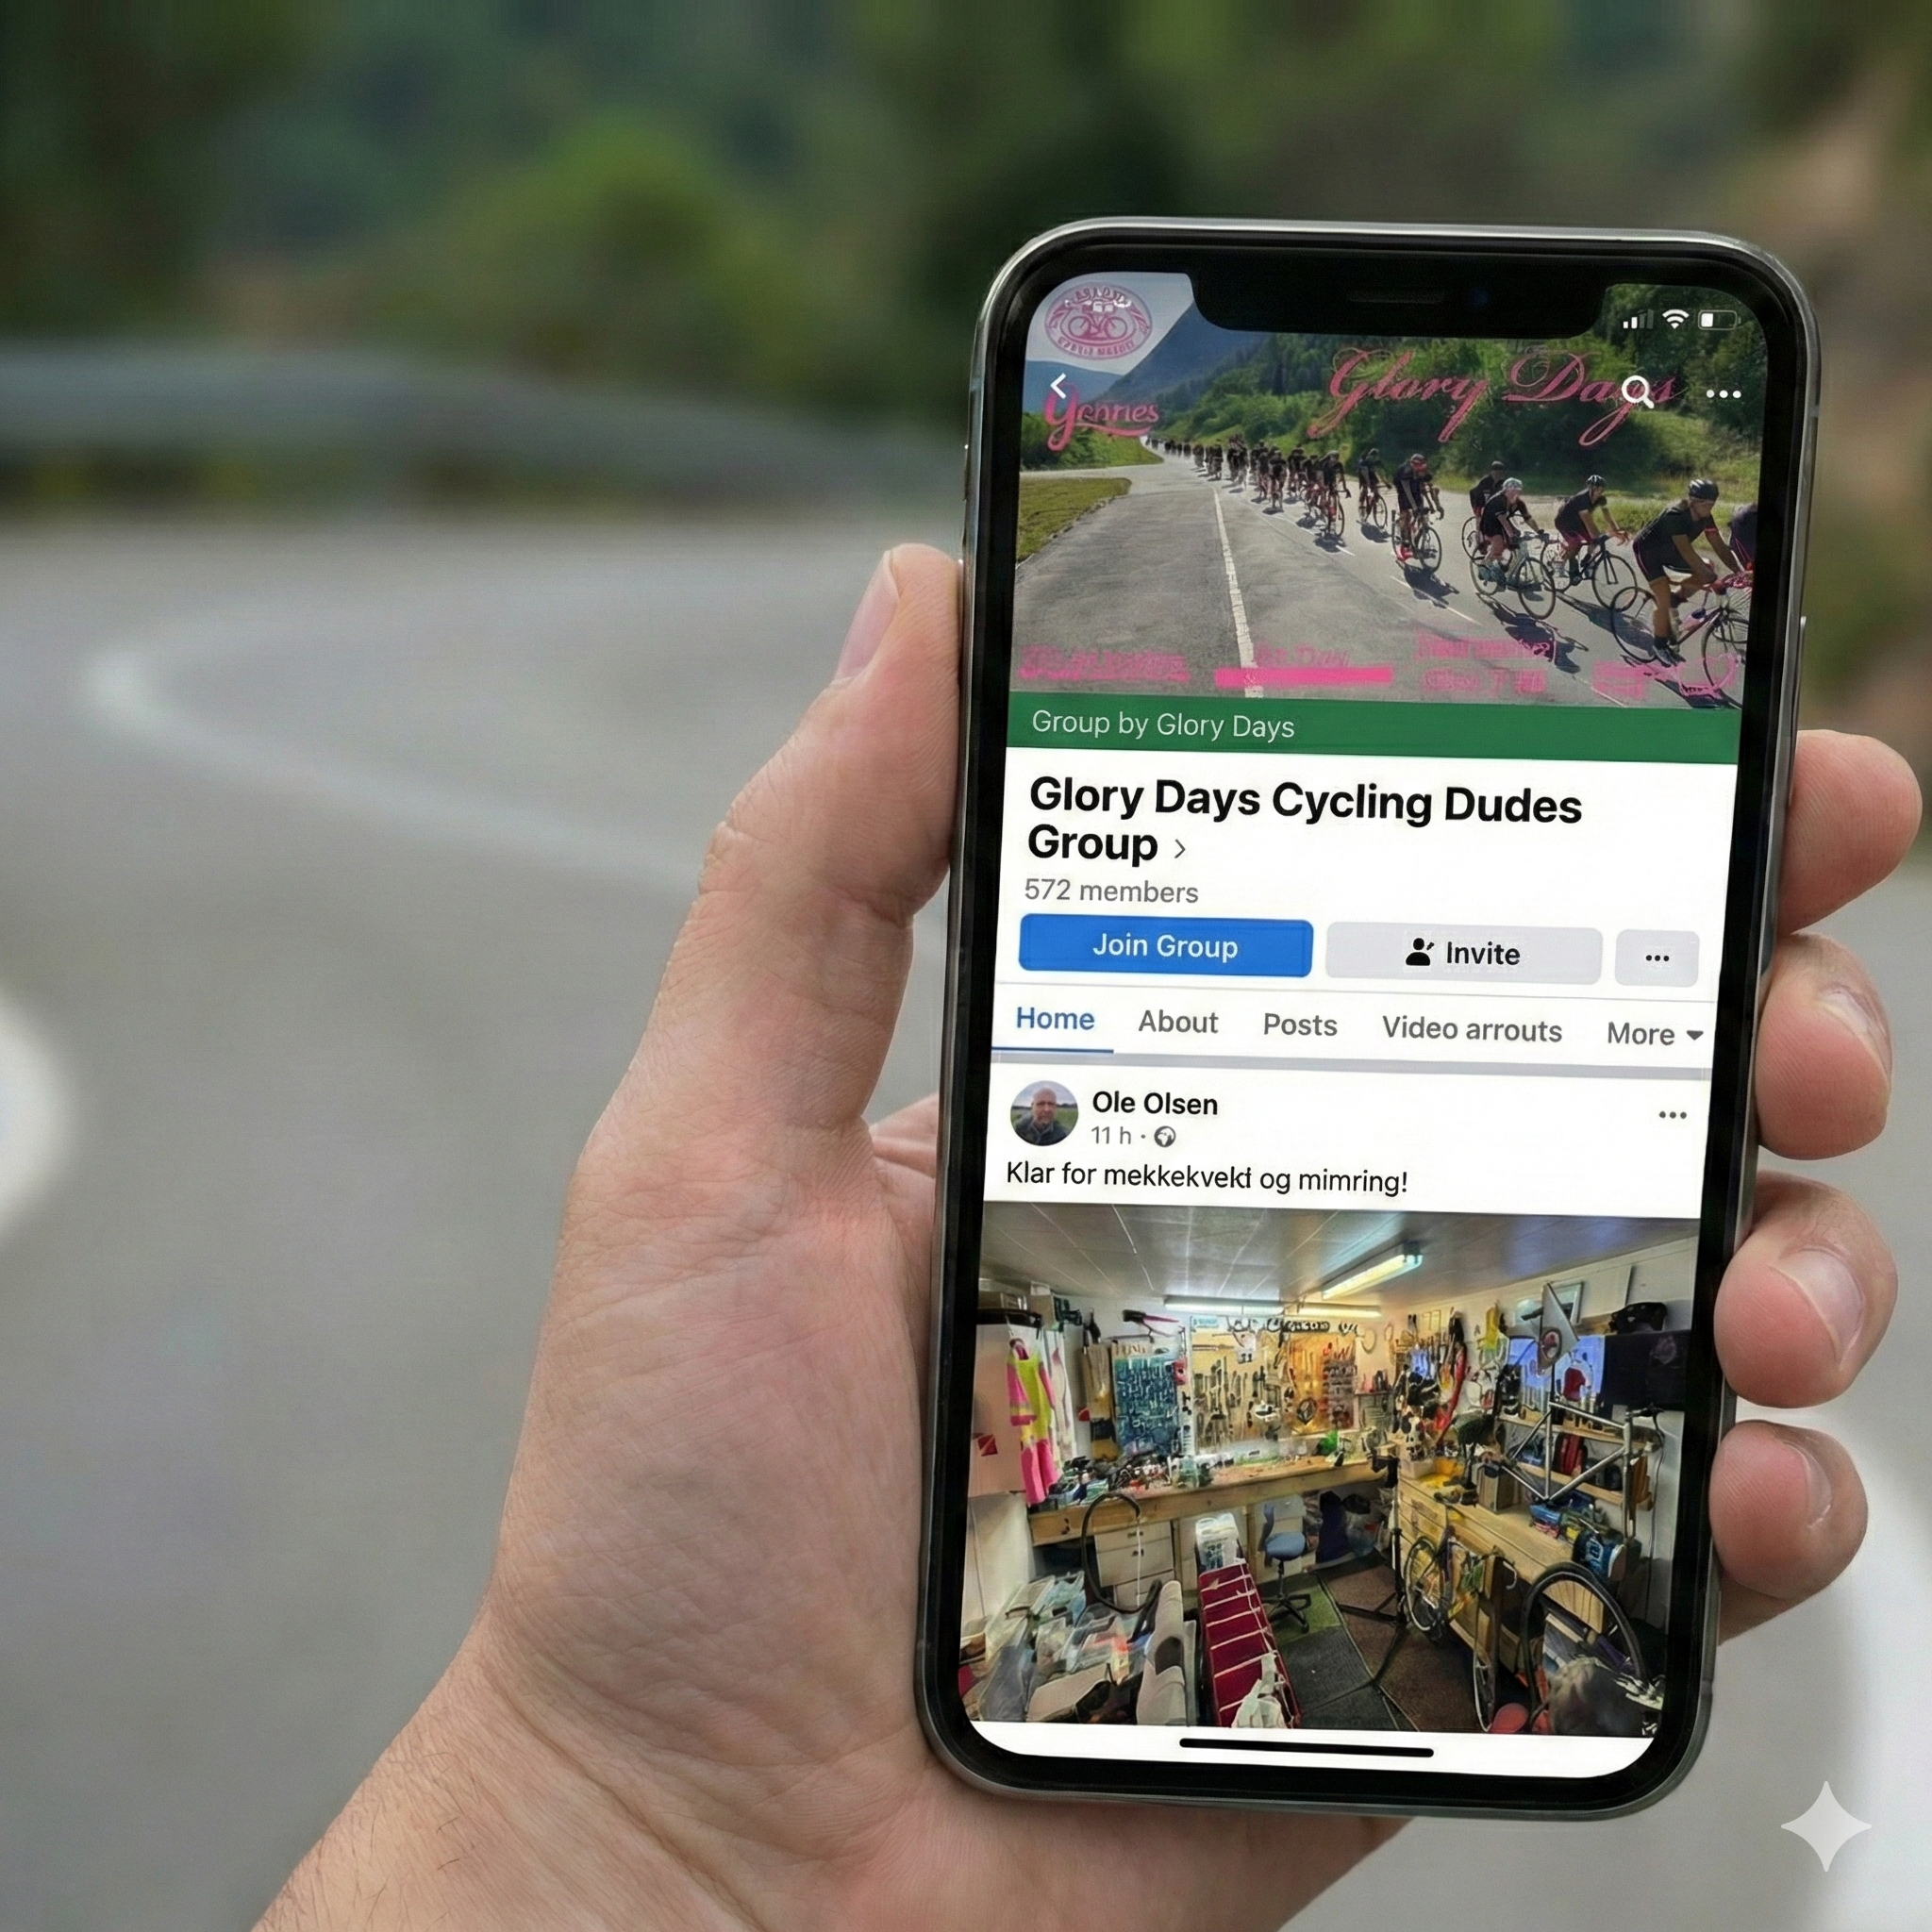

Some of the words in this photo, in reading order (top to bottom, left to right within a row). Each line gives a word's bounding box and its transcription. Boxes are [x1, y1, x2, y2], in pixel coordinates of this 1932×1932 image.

[1307, 347, 1488, 443] Glory
[1501, 347, 1685, 446] Days
[1032, 709, 1110, 739] Group
[1119, 710, 1149, 740] by
[1157, 712, 1224, 742] Glory
[1233, 714, 1295, 743] Days
[1030, 776, 1144, 820] Glory
[1156, 779, 1260, 823] Days
[1273, 782, 1433, 827] Cycling
[1445, 787, 1582, 824] Dudes
[1028, 824, 1158, 868] Group
[1024, 877, 1071, 901] 572
[1079, 879, 1199, 904] members
[1092, 932, 1148, 957] Join
[1157, 934, 1239, 963] Group
[1446, 941, 1521, 966] Invite
[1016, 1006, 1095, 1031] Home
[1138, 1008, 1220, 1034] About
[1263, 1012, 1338, 1037] Posts
[1382, 1014, 1458, 1040] Video
[1465, 1021, 1563, 1043] arrouts
[1607, 1021, 1675, 1046] More
[1092, 1091, 1136, 1114] Ole
[1143, 1091, 1218, 1116] Olsen
[1091, 1125, 1110, 1144] 11
[1119, 1125, 1132, 1145] h
[1007, 1160, 1056, 1184] Klar
[1061, 1161, 1098, 1185] for
[1259, 1172, 1291, 1195] og
[1298, 1168, 1407, 1198] mimring!
